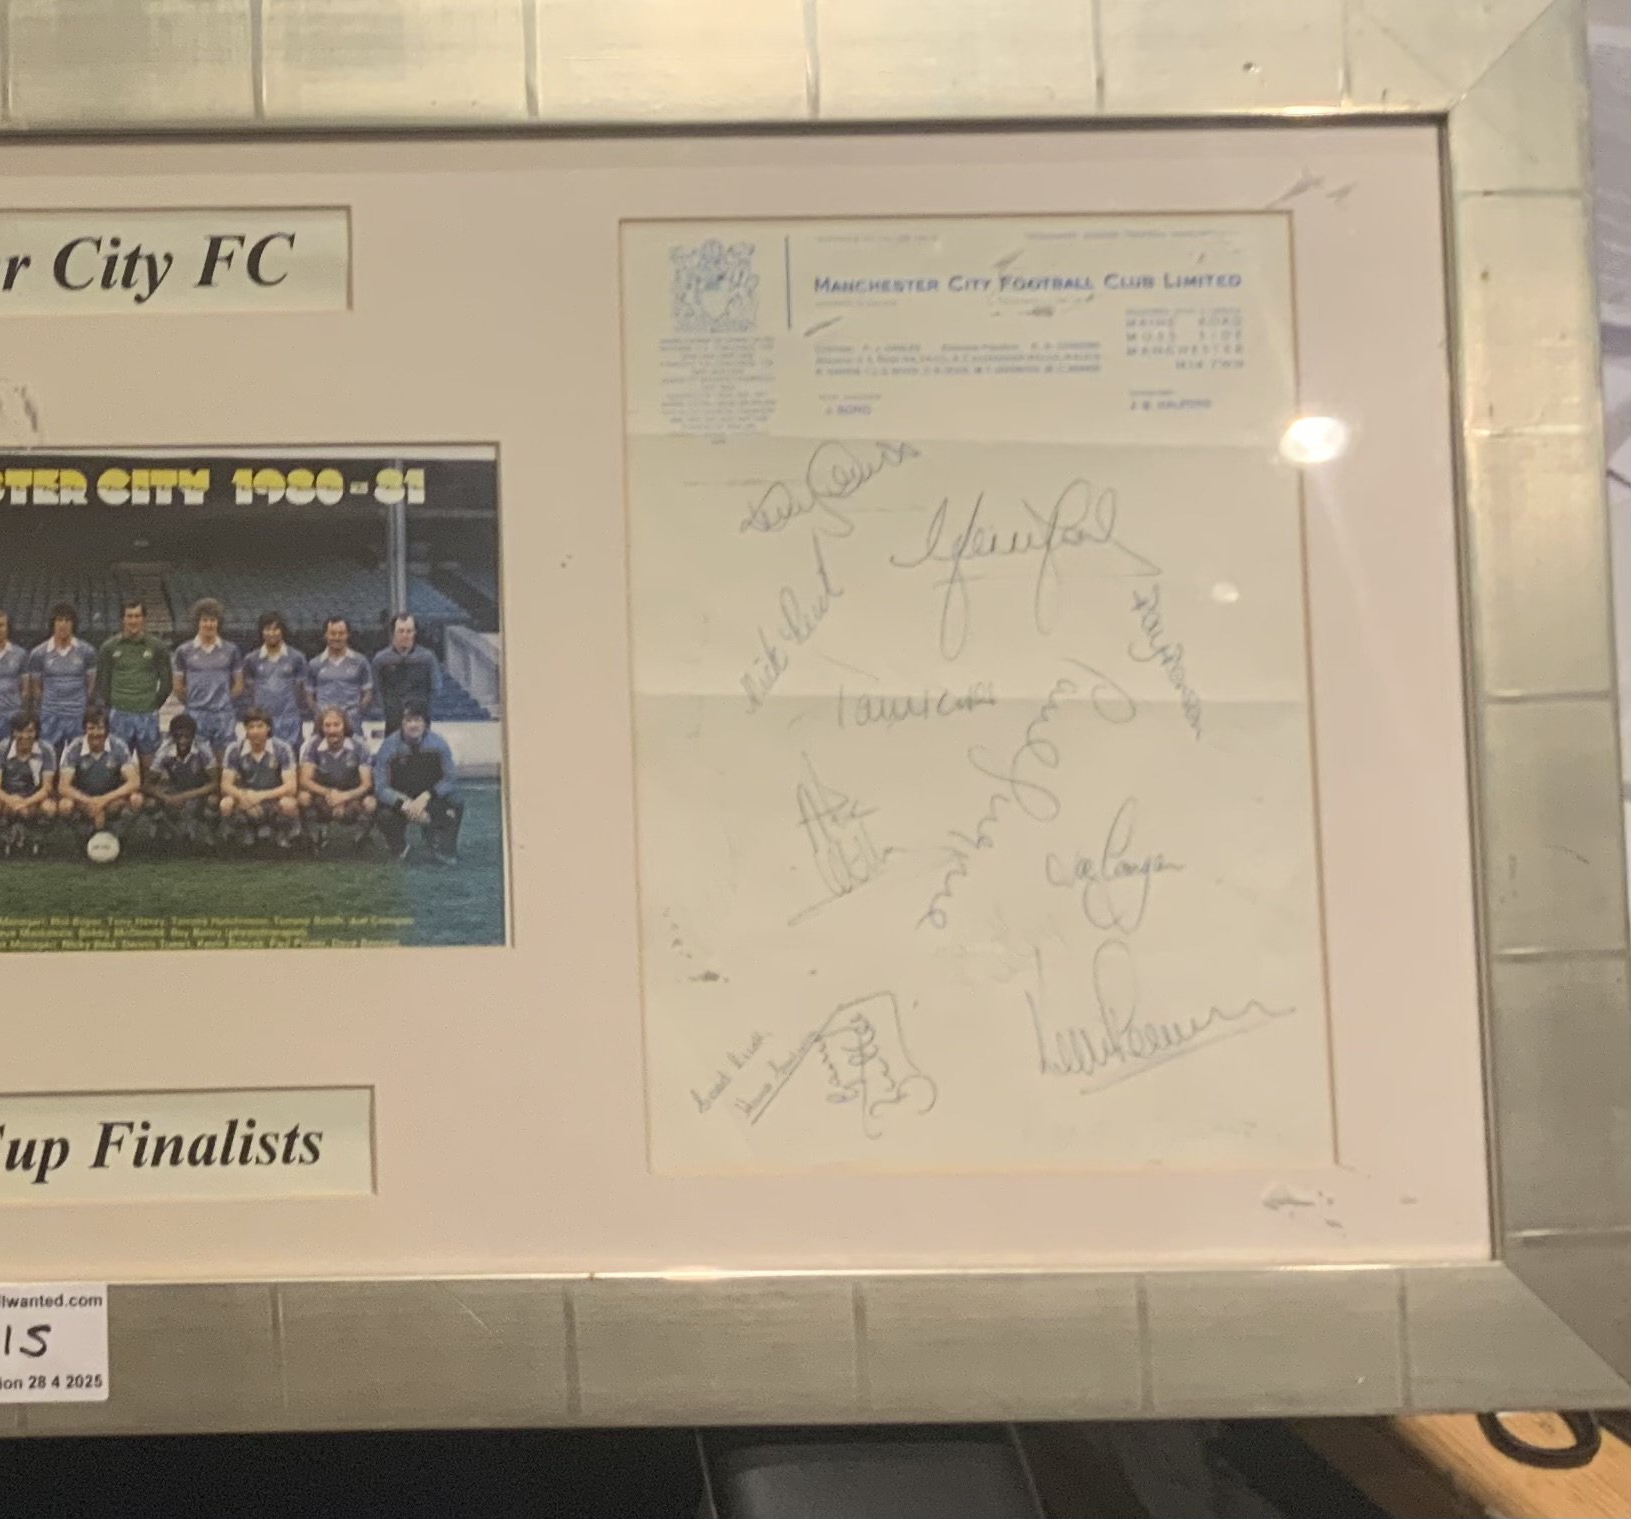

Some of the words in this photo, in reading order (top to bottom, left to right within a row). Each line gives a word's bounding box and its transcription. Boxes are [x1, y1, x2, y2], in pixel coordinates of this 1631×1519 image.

[52, 236, 175, 304] City
[193, 231, 297, 288] FC
[948, 273, 992, 293] CITY
[1103, 271, 1156, 290] CLUB
[1163, 271, 1243, 290] LIMITED
[96, 468, 211, 506] CITY
[89, 1118, 324, 1170] Finalists
[27, 1374, 47, 1390] 28
[51, 1373, 61, 1389] 4
[65, 1373, 104, 1390] 2025
